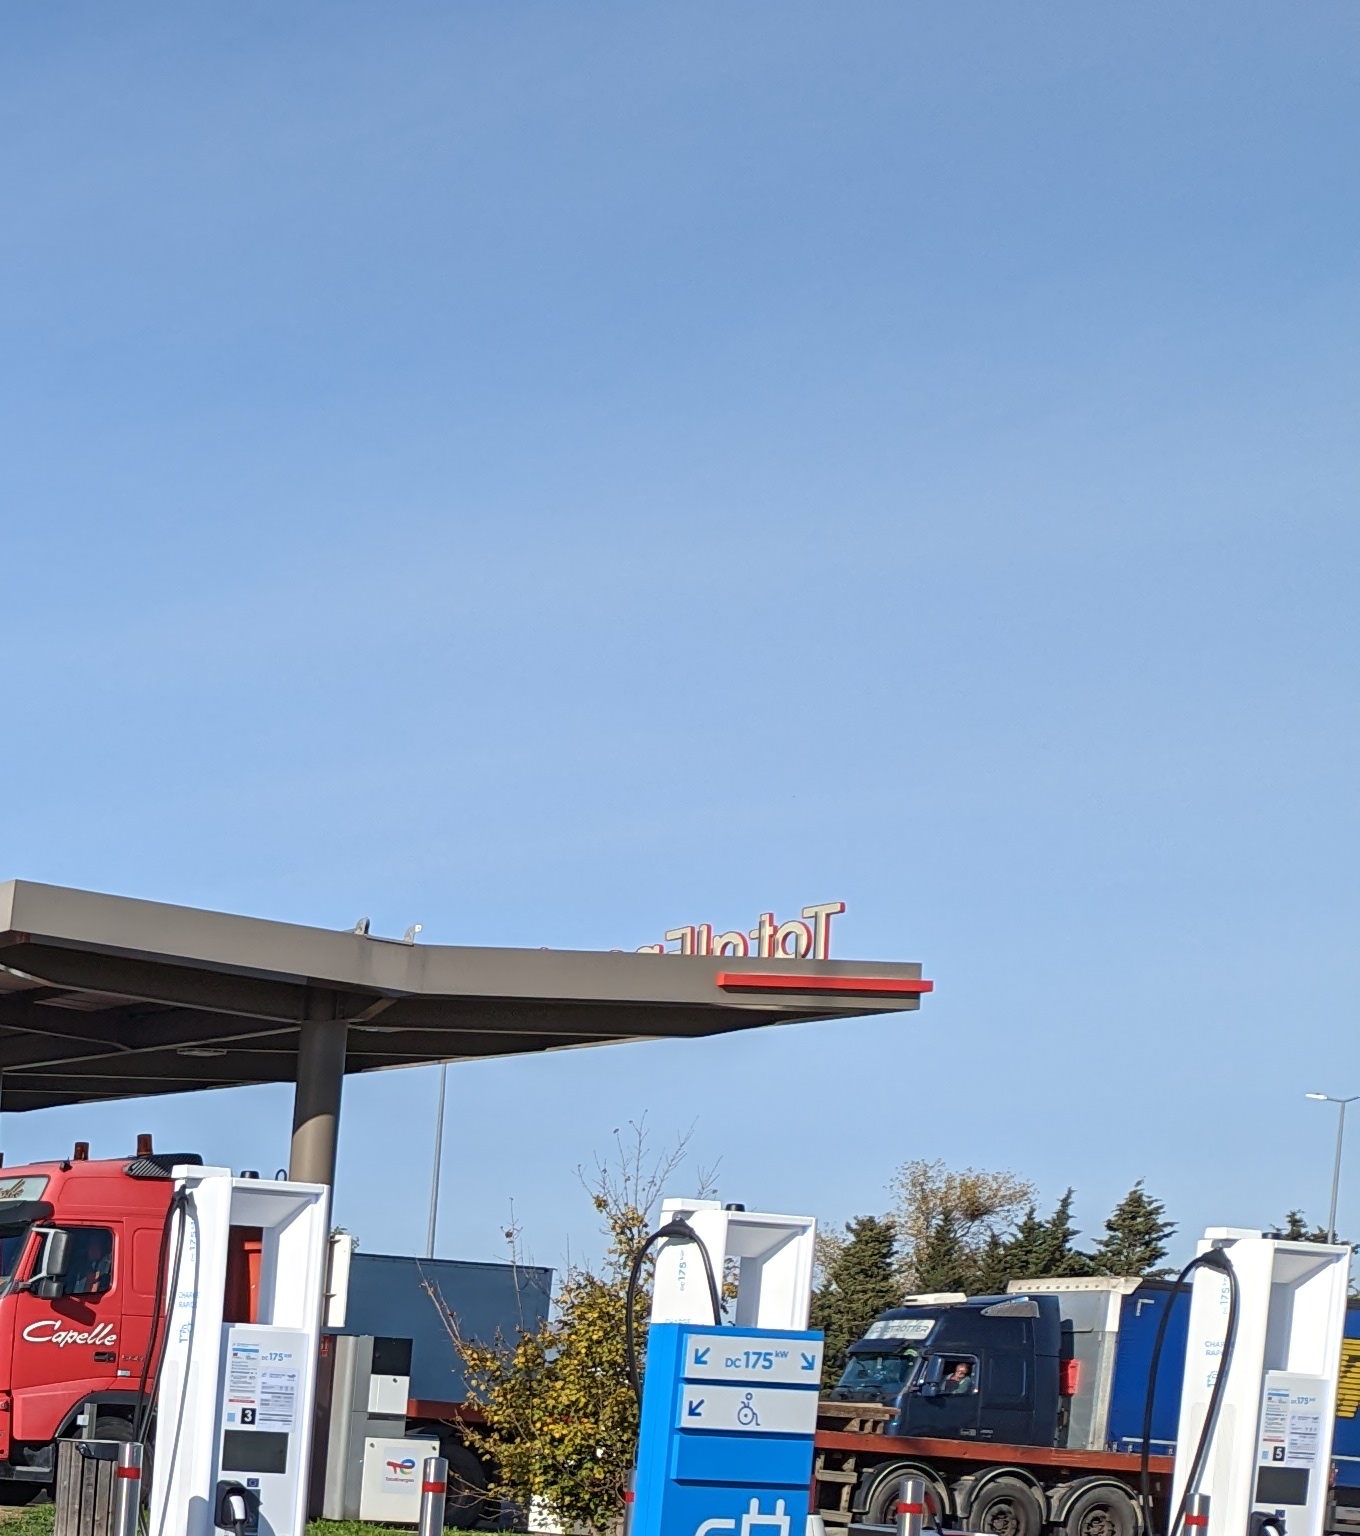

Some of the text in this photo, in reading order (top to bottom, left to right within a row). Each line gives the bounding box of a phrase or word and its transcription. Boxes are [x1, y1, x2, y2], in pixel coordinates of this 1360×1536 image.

[23, 1320, 117, 1347] Capelle
[243, 1409, 252, 1422] 3
[1275, 1447, 1283, 1459] 5
